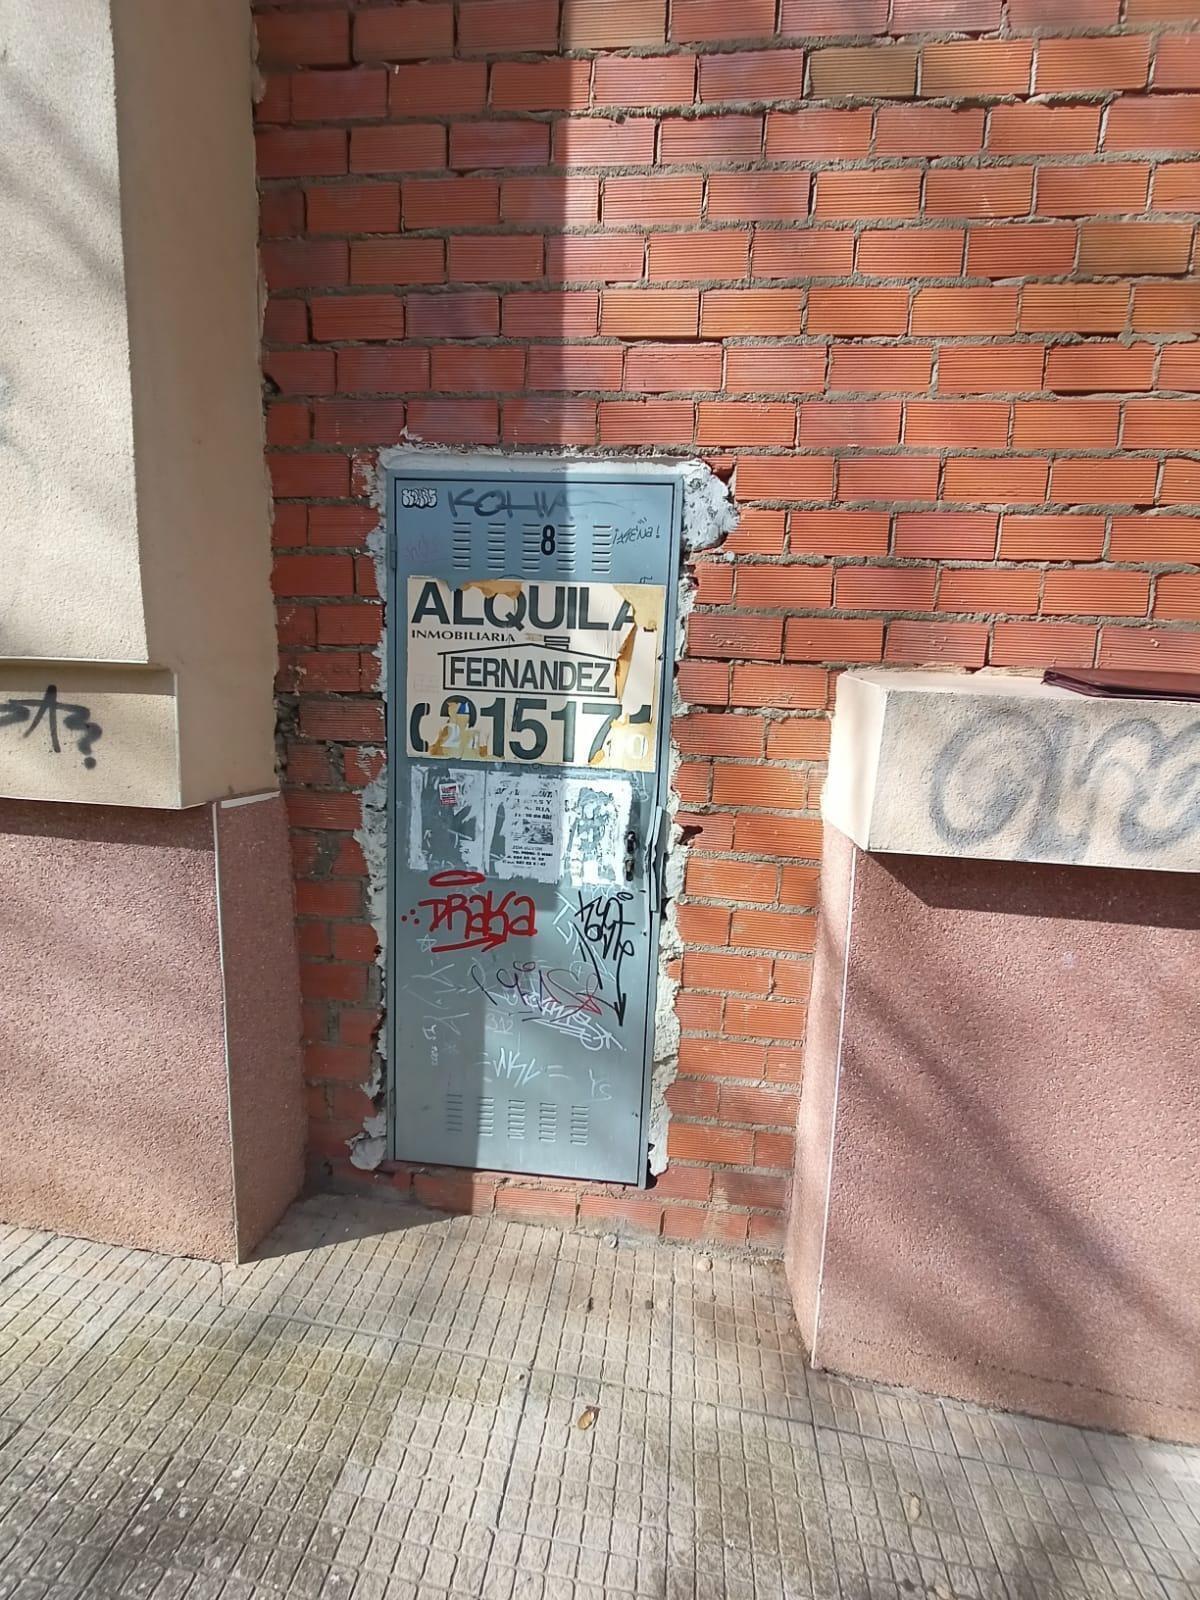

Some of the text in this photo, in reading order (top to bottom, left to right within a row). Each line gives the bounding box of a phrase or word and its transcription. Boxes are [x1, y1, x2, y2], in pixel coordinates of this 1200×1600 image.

[540, 524, 556, 556] 8
[411, 628, 516, 643] INMOBILIARIA
[449, 655, 611, 693] FERNANDEZ
